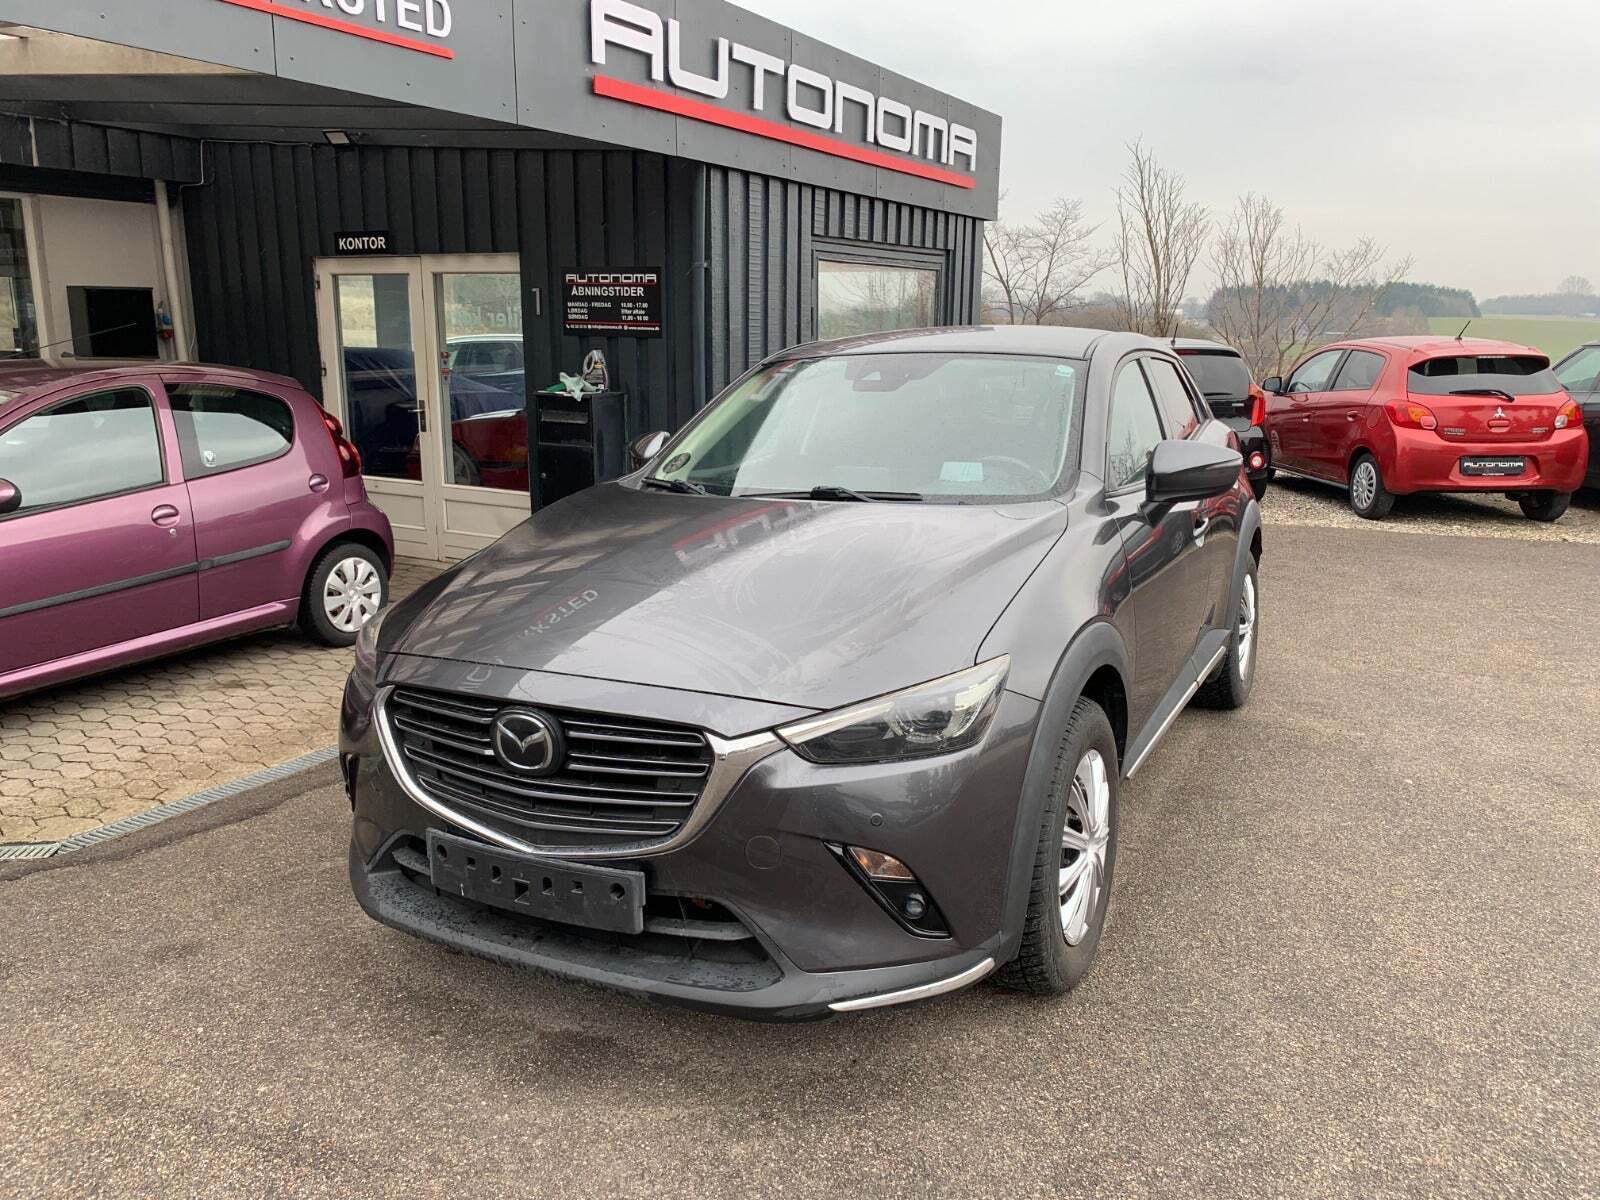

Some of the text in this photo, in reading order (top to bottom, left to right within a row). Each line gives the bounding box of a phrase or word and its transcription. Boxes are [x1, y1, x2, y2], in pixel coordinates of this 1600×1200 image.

[591, 0, 977, 172] AUTONOMA
[338, 236, 386, 250] KONTOR
[565, 273, 657, 283] AUTONOMA
[571, 285, 645, 297] ÅBNINGSTIDER
